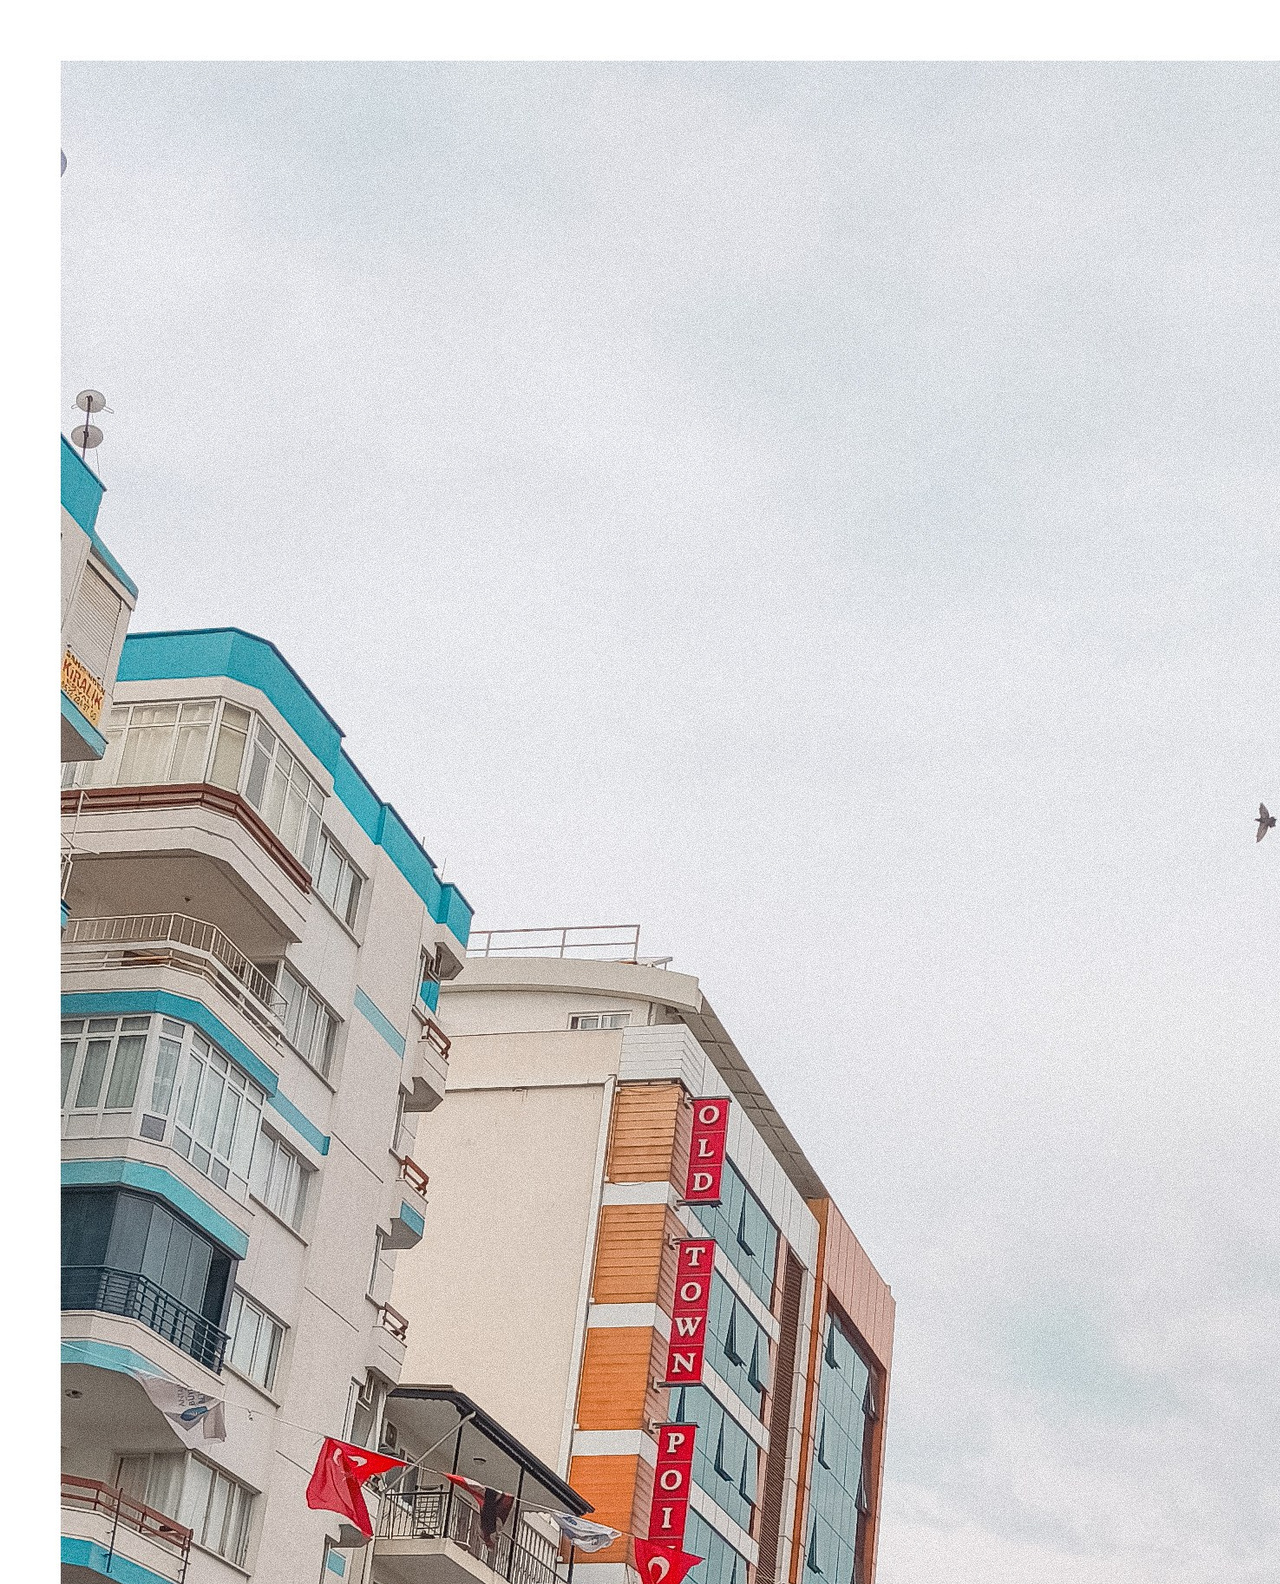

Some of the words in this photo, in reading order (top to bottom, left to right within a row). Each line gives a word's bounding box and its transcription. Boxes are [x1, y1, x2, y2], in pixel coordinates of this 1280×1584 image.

[691, 1105, 720, 1192] OLD
[671, 1246, 706, 1374] TOWN
[660, 1432, 685, 1550] POI
